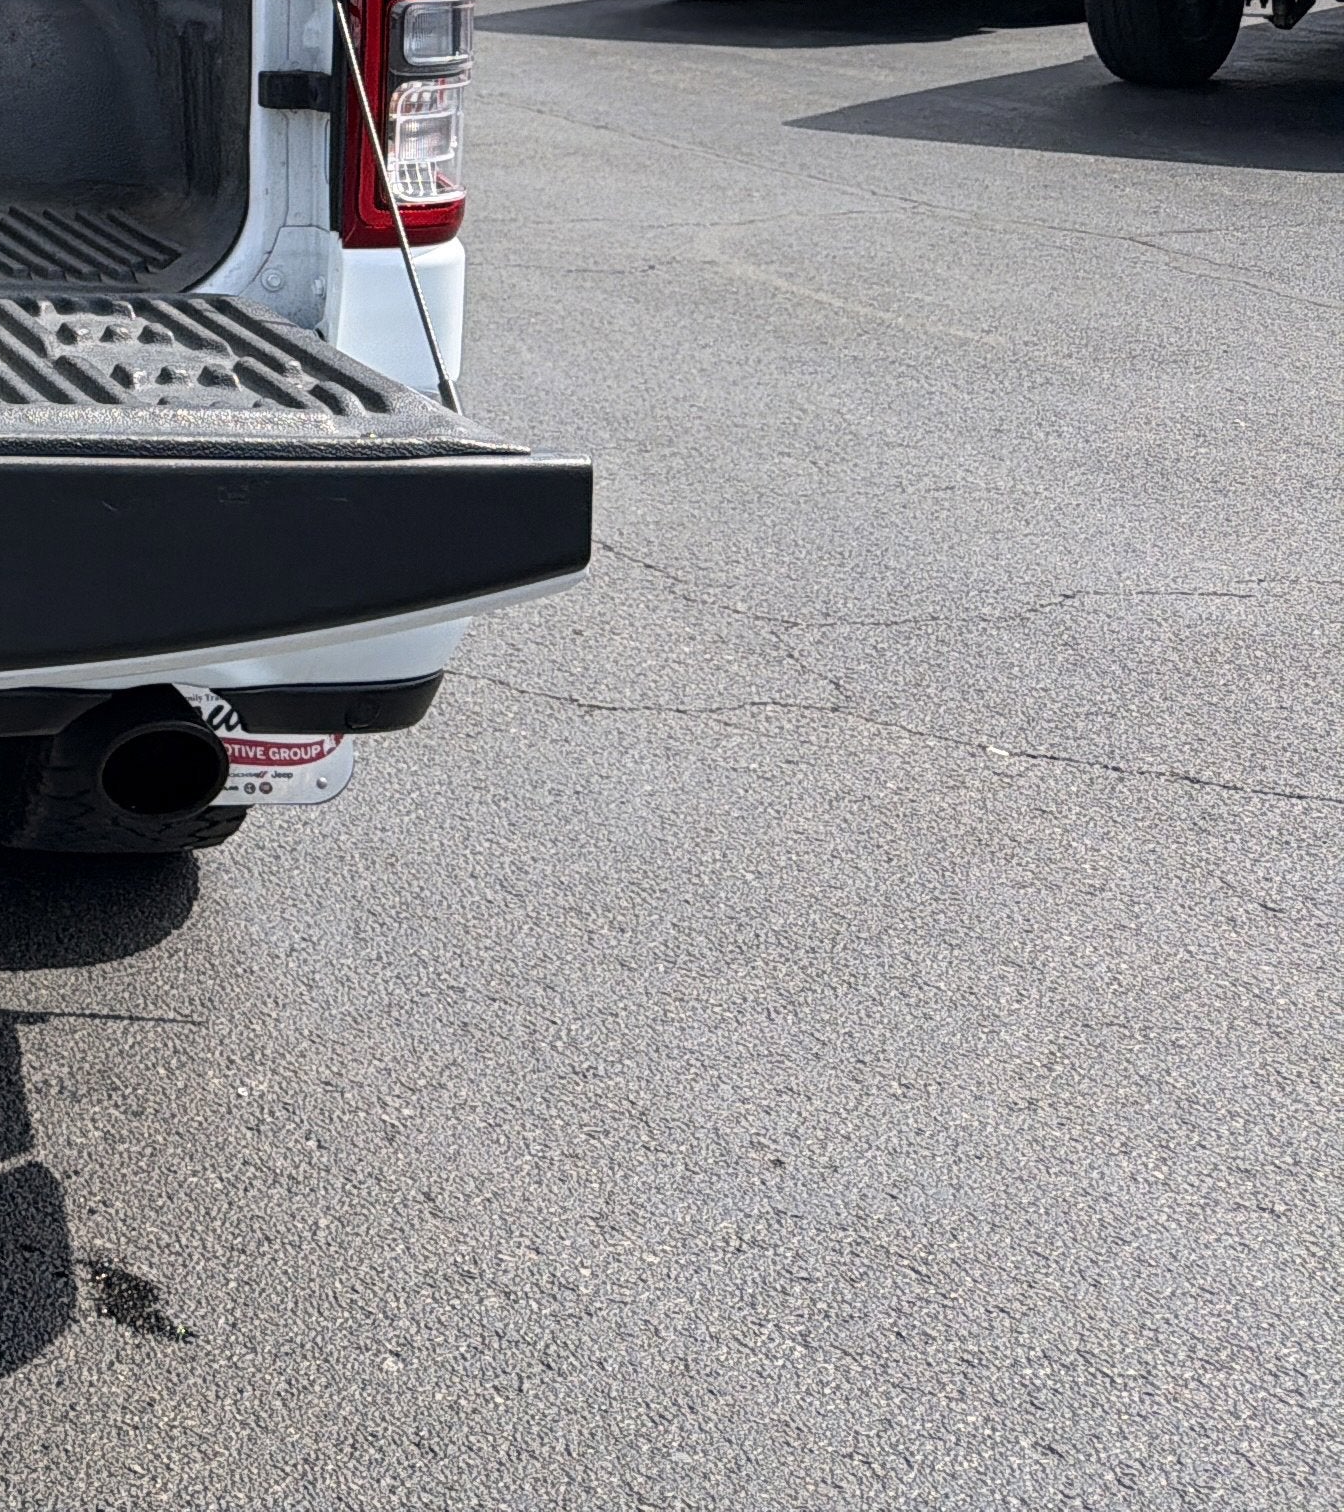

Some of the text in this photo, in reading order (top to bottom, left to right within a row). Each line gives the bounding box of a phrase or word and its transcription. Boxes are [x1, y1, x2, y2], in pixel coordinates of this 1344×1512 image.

[224, 744, 321, 760] OTIVE GROUP
[271, 771, 293, 780] Jeep
